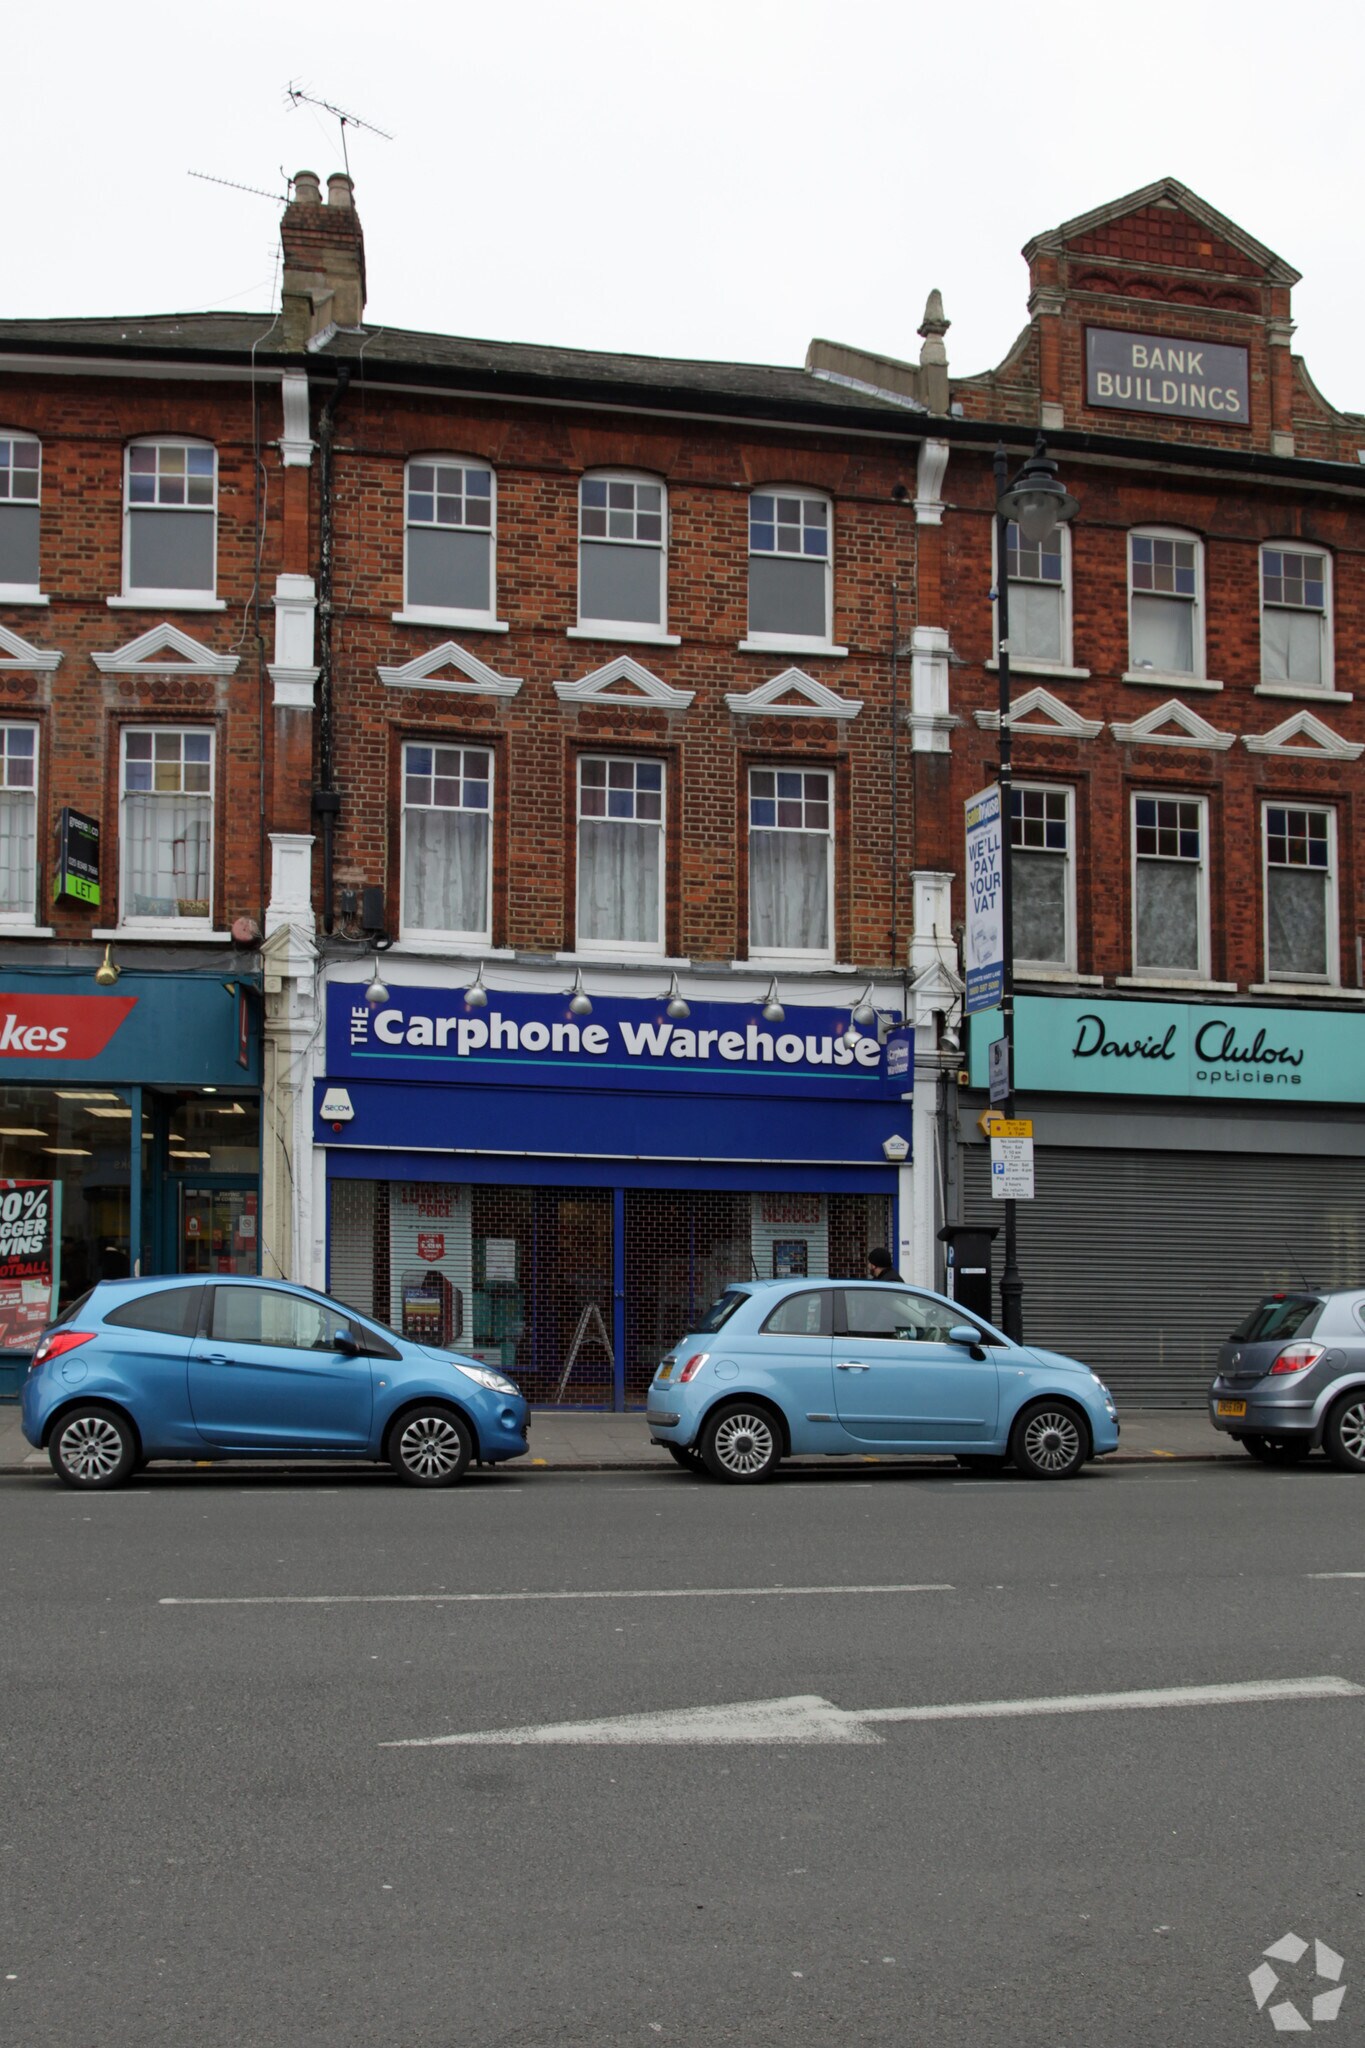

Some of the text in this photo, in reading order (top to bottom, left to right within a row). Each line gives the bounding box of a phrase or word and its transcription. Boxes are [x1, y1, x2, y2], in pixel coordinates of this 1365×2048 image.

[1132, 344, 1204, 376] BANK
[1097, 372, 1240, 412] BUILDINGS
[969, 835, 1001, 861] WE'LL
[974, 854, 995, 877] PAY
[76, 880, 92, 899] LET
[970, 872, 1001, 897] YOUR
[974, 893, 996, 914] VAT
[0, 1014, 69, 1052] kes
[351, 1007, 881, 1067] THE Carphone Warehouse
[1072, 1014, 1304, 1066] David Clulow
[1196, 1069, 1302, 1084] opticians
[0, 1190, 48, 1222] 0%
[418, 1204, 453, 1218] PRICE
[0, 1219, 47, 1239] GGER
